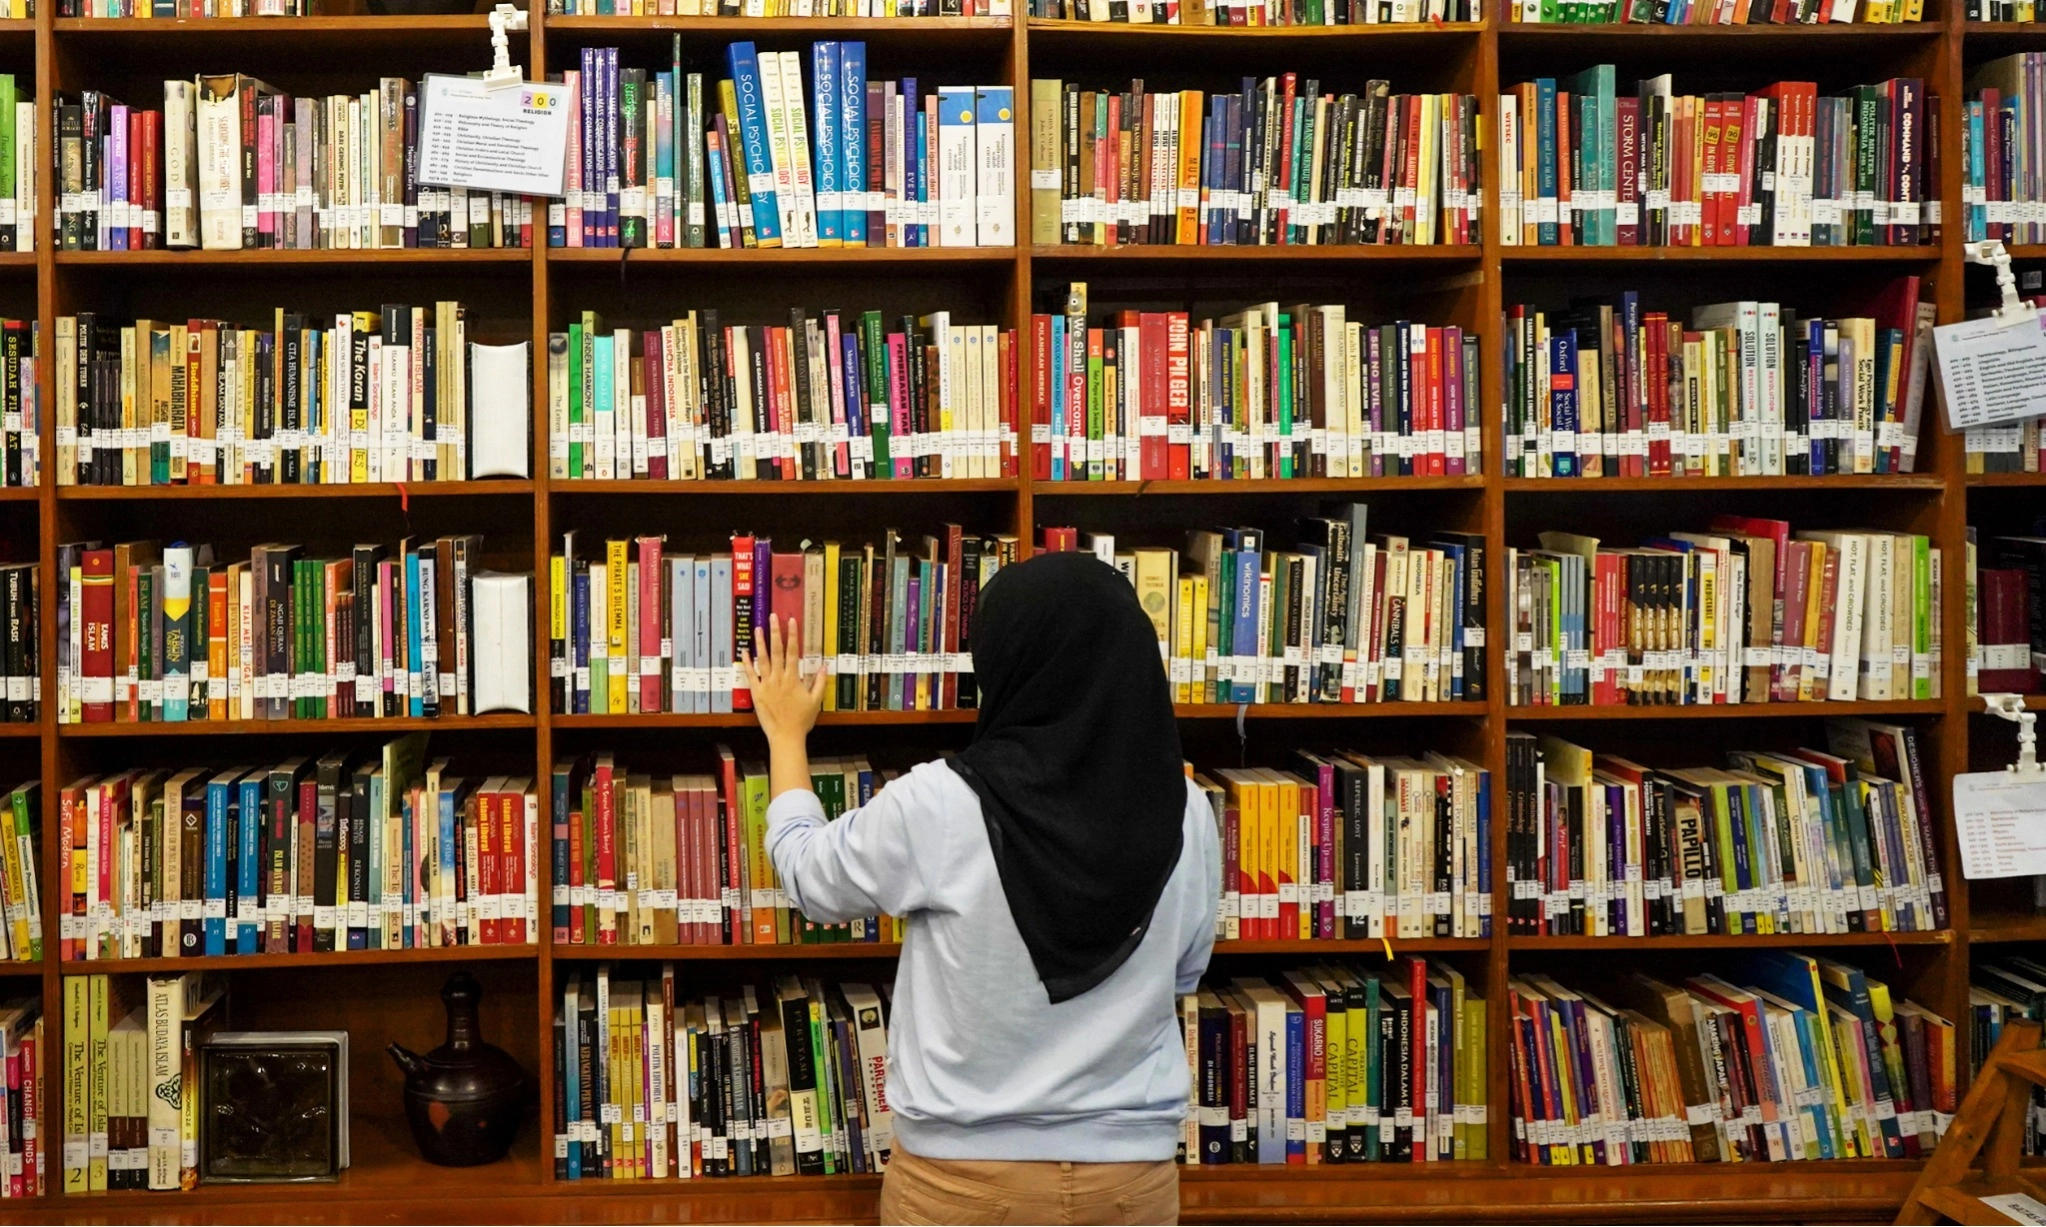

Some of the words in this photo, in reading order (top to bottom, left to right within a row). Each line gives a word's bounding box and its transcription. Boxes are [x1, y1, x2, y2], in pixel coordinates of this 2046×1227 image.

[740, 74, 756, 122] SOCIAL
[821, 74, 832, 119] SOCIAL
[847, 76, 859, 119] SOCIAL
[1304, 118, 1314, 151] TRANSISI
[1623, 115, 1634, 157] STORM
[1902, 113, 1911, 162] COMMAND
[1303, 153, 1311, 181] MENUJU
[1073, 317, 1084, 338] We
[1169, 316, 1187, 351] JOHN
[1629, 302, 1637, 333] Perangkat
[288, 342, 296, 361] CITA
[355, 340, 366, 362] The
[666, 331, 675, 372] DIASPORA
[1073, 341, 1084, 372] Shall
[1349, 328, 1357, 353] Health
[1371, 336, 1379, 357] SEE
[1559, 341, 1567, 372] Oxford
[1630, 334, 1638, 370] Pembangun
[1745, 331, 1758, 367] SOLUTION
[1766, 333, 1776, 369] SOLUTION
[8, 337, 17, 389] SESUDAH
[1349, 355, 1357, 377] Policy
[1372, 361, 1379, 377] NO
[190, 362, 198, 417] Buddhisme
[288, 362, 296, 408] HUMANISME
[354, 365, 366, 401] Koran
[1169, 357, 1187, 407] PILGER
[1372, 382, 1380, 409] EVIL
[1556, 393, 1564, 401] &
[1865, 374, 1873, 415] Psychology
[172, 366, 185, 431] MAHABHARATA
[1074, 376, 1084, 438] Overcome
[1556, 403, 1565, 426] Social
[1563, 393, 1571, 415] Social
[613, 545, 621, 560] THE
[736, 562, 751, 570] WHAT
[1471, 548, 1482, 568] Asian
[614, 562, 623, 595] PIRATE'S
[737, 582, 750, 591] SAID
[738, 572, 749, 580] SHE
[1242, 562, 1253, 618] wikinomics
[1331, 567, 1341, 617] Uncertainty
[1470, 569, 1481, 605] Godfathers
[213, 601, 222, 627] Hamka
[422, 592, 430, 620] KARNO
[1340, 606, 1346, 616] of
[1705, 580, 1713, 619] PREDICTABLE
[1846, 593, 1854, 631] CROWDED
[1390, 598, 1403, 644] CANNIBALS
[62, 799, 72, 822] Sufi
[480, 798, 488, 821] Islam
[503, 799, 512, 821] Islam
[1322, 808, 1332, 842] Keeping
[1517, 791, 1525, 834] Criminology
[62, 826, 71, 869] Modern
[468, 833, 476, 869] Buddha
[480, 823, 489, 852] Liberal
[504, 824, 512, 853] Liberal
[1322, 843, 1332, 855] Up
[1681, 818, 1701, 879] PAPILLO
[155, 993, 166, 1018] ATLAS
[98, 1040, 106, 1057] The
[155, 1019, 167, 1051] BUDAYA
[1187, 1028, 1196, 1048] Reksa
[1313, 1019, 1324, 1056] SUKARNO
[1400, 1009, 1409, 1063] INDONESIA
[74, 1042, 84, 1062] The
[156, 1052, 168, 1077] ISLAM
[652, 1044, 660, 1070] POLITIK
[1188, 1049, 1196, 1067] Dana
[1314, 1057, 1323, 1073] FILE
[1346, 1038, 1358, 1096] CAPITAL
[1707, 1019, 1720, 1056] AMAZING
[1715, 1058, 1726, 1088] JAPAN!
[74, 1066, 84, 1104] Venture
[97, 1061, 106, 1097] Venture
[653, 1071, 662, 1104] EDITORIAL
[872, 1056, 890, 1113] PARLEMEN
[1248, 1067, 1256, 1105] BERHEMAT
[1326, 1043, 1338, 1100] CAPITAL
[1400, 1063, 1408, 1098] DALAM
[74, 1108, 83, 1118] of
[98, 1100, 106, 1110] of
[98, 1114, 106, 1132] Isla
[71, 1168, 81, 1183] 2
